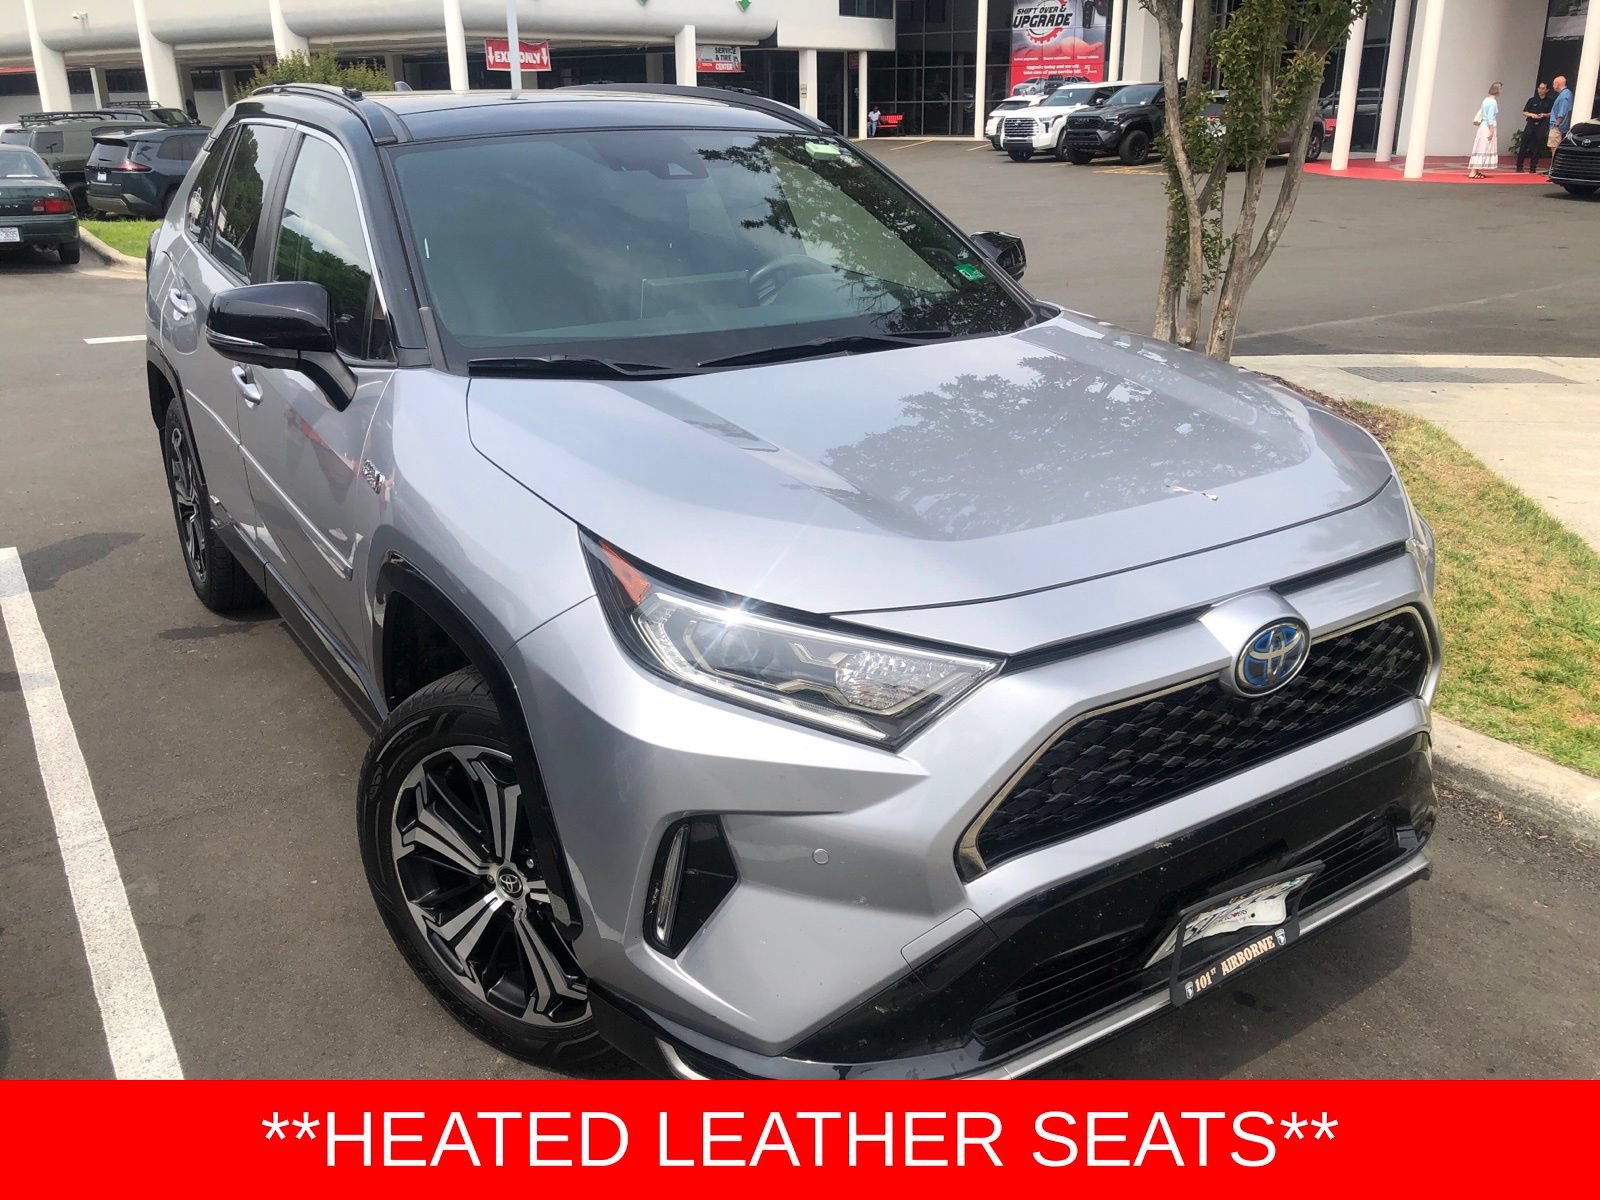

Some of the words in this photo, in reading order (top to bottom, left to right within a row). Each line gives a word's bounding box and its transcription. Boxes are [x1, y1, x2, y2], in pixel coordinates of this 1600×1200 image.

[1016, 7, 1038, 15] SHIFT
[1039, 6, 1058, 14] OVER
[1060, 4, 1067, 13] &
[1013, 13, 1073, 28] UPGRADE
[494, 51, 511, 63] EXI
[519, 51, 541, 64] ONLY
[714, 47, 737, 55] SERVICE
[1220, 935, 1276, 976] AIRBORNE
